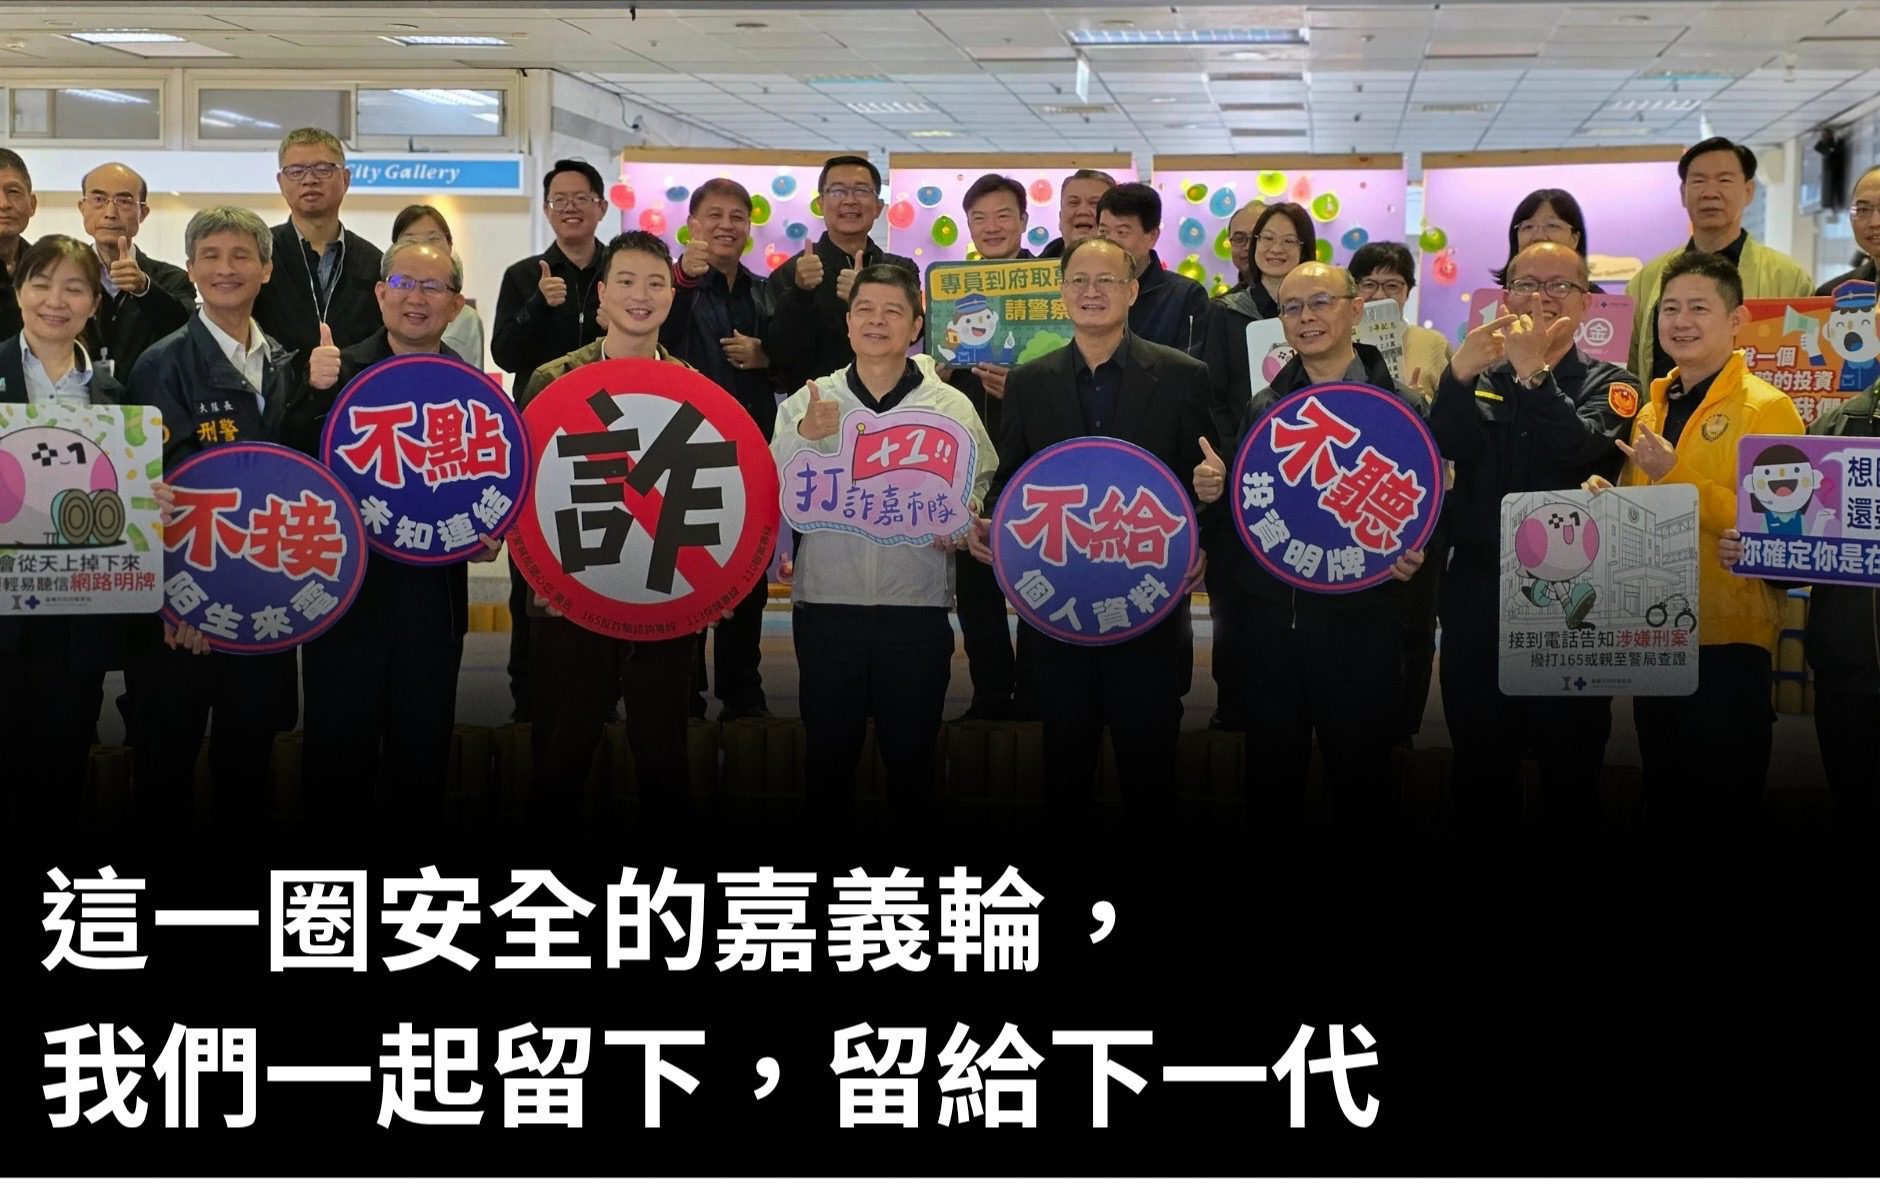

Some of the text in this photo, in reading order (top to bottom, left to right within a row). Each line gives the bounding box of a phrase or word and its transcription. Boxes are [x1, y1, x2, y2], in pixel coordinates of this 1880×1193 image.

[347, 164, 461, 184] City Gallery
[1005, 299, 1070, 320] 請警察
[197, 418, 239, 442] 刑警
[336, 399, 512, 492] 不點
[555, 388, 738, 595] 詐
[796, 463, 957, 528] 打詐嘉市隊
[1270, 396, 1426, 556] 不聽
[1848, 456, 1880, 488] 想
[162, 488, 348, 582] 不接
[360, 484, 513, 552] 未知連結
[1005, 483, 1187, 570] 不給
[1242, 472, 1366, 582] 投資明牌
[1847, 497, 1880, 530] 還
[0, 553, 140, 573] 會從天上掉下來
[1740, 536, 1880, 575] 你確定你是在
[0, 572, 156, 592] 輕易聽信網路明牌
[164, 571, 339, 640] 陌生來電
[1014, 569, 1170, 634] 個人資料
[1508, 630, 1690, 650] 接到電話告知涉嫌刑案
[1530, 652, 1688, 668] 撥打165或親至警局查證
